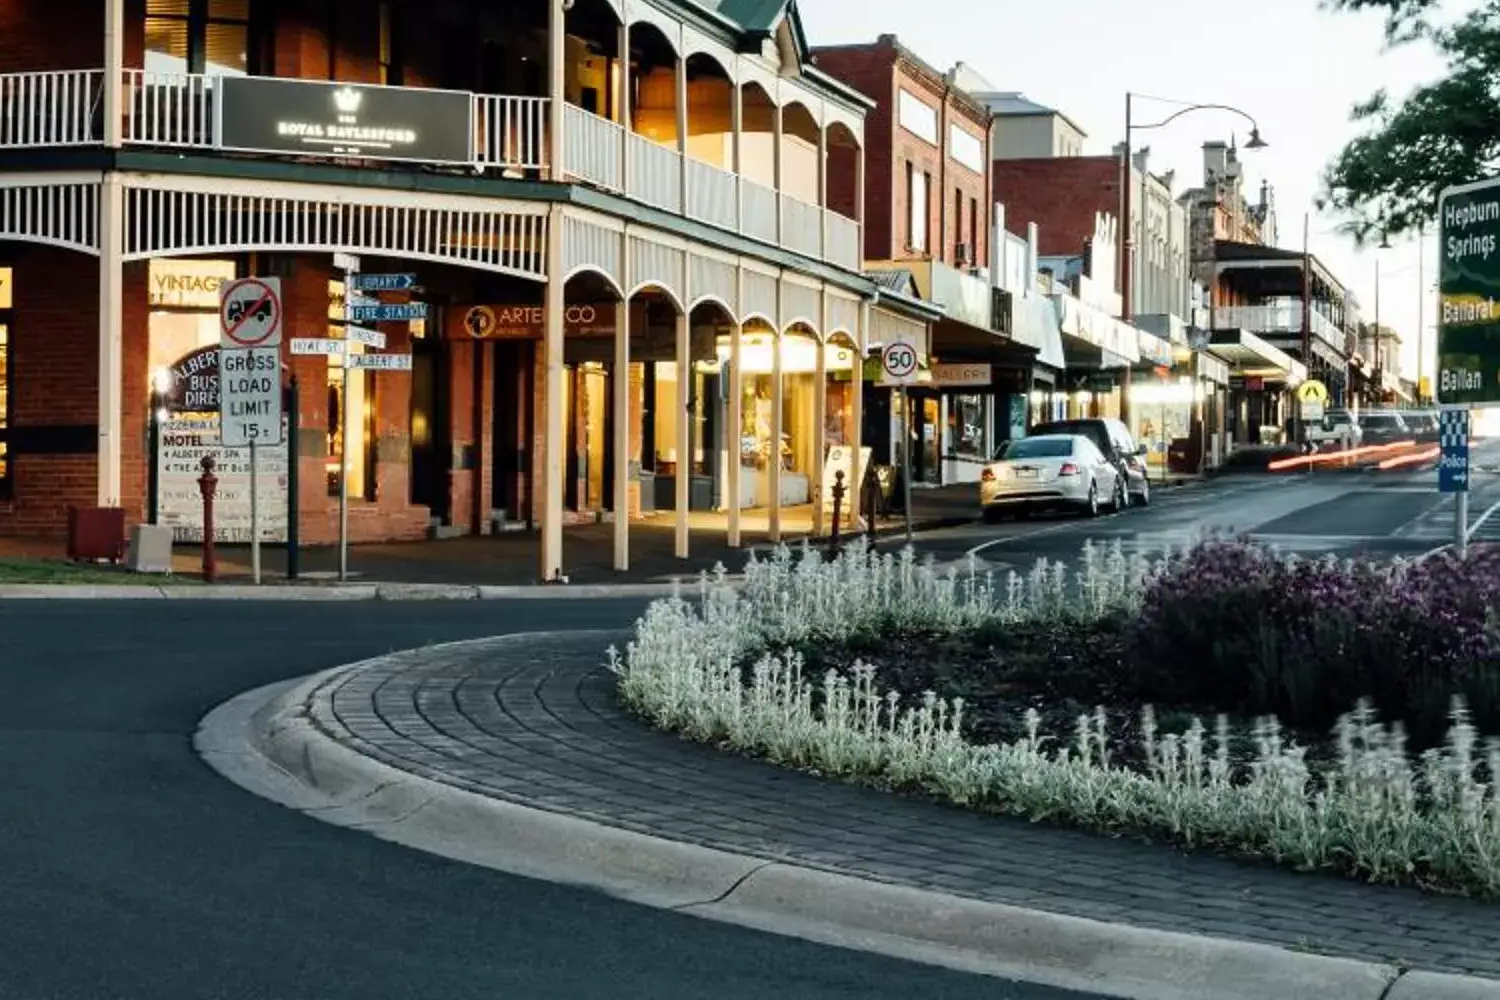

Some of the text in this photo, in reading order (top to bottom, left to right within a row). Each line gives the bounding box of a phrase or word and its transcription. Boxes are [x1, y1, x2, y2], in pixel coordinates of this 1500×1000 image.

[1445, 201, 1500, 230] Hepburn
[1447, 232, 1496, 263] Springs
[355, 304, 428, 319] FIRE STATION
[499, 305, 596, 324] ARTECO
[1443, 296, 1494, 324] Ballarat
[225, 355, 275, 371] GROSS
[889, 351, 912, 369] 50
[191, 375, 219, 391] BUS
[229, 378, 271, 393] LOAD
[1441, 369, 1483, 392] Ballan
[231, 401, 270, 416] LIMIT
[243, 423, 259, 439] 15
[163, 435, 203, 447] MOTEL
